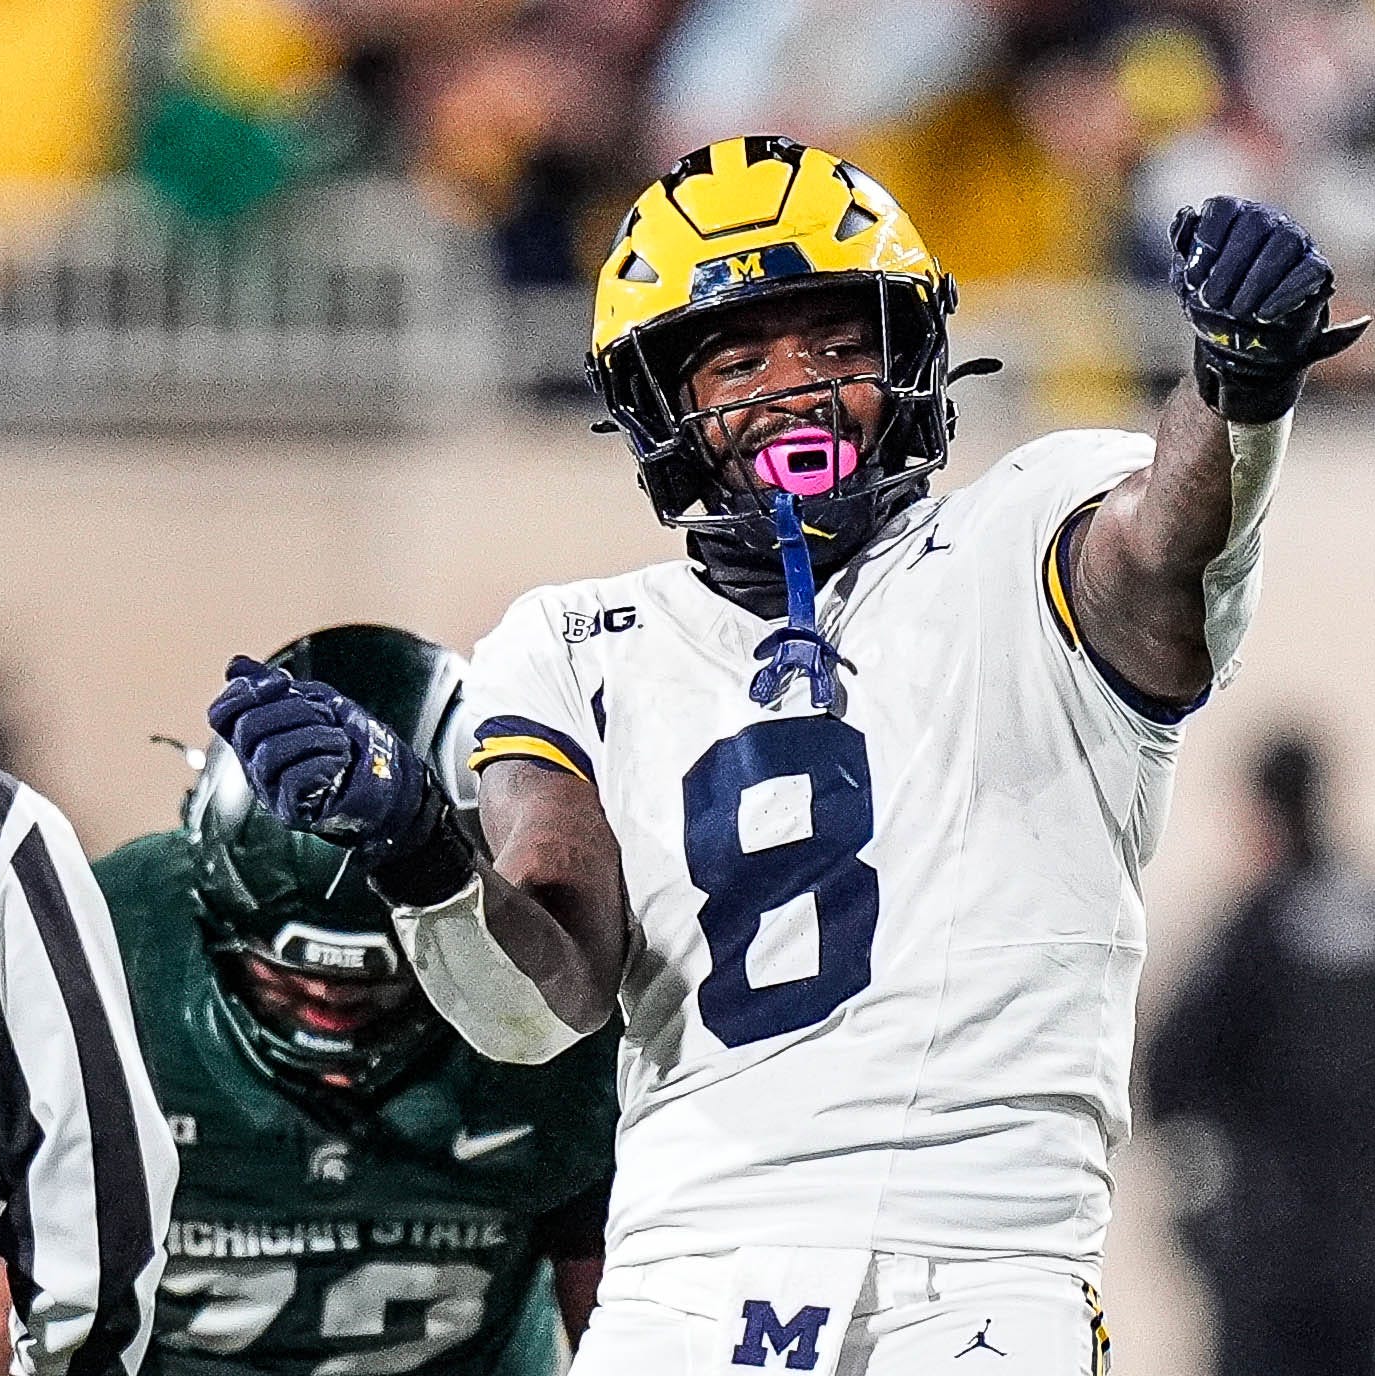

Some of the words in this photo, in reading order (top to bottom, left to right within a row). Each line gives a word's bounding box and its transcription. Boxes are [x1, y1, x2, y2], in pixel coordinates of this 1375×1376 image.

[729, 252, 765, 281] M
[683, 711, 880, 1049] 8
[732, 1300, 830, 1371] M
